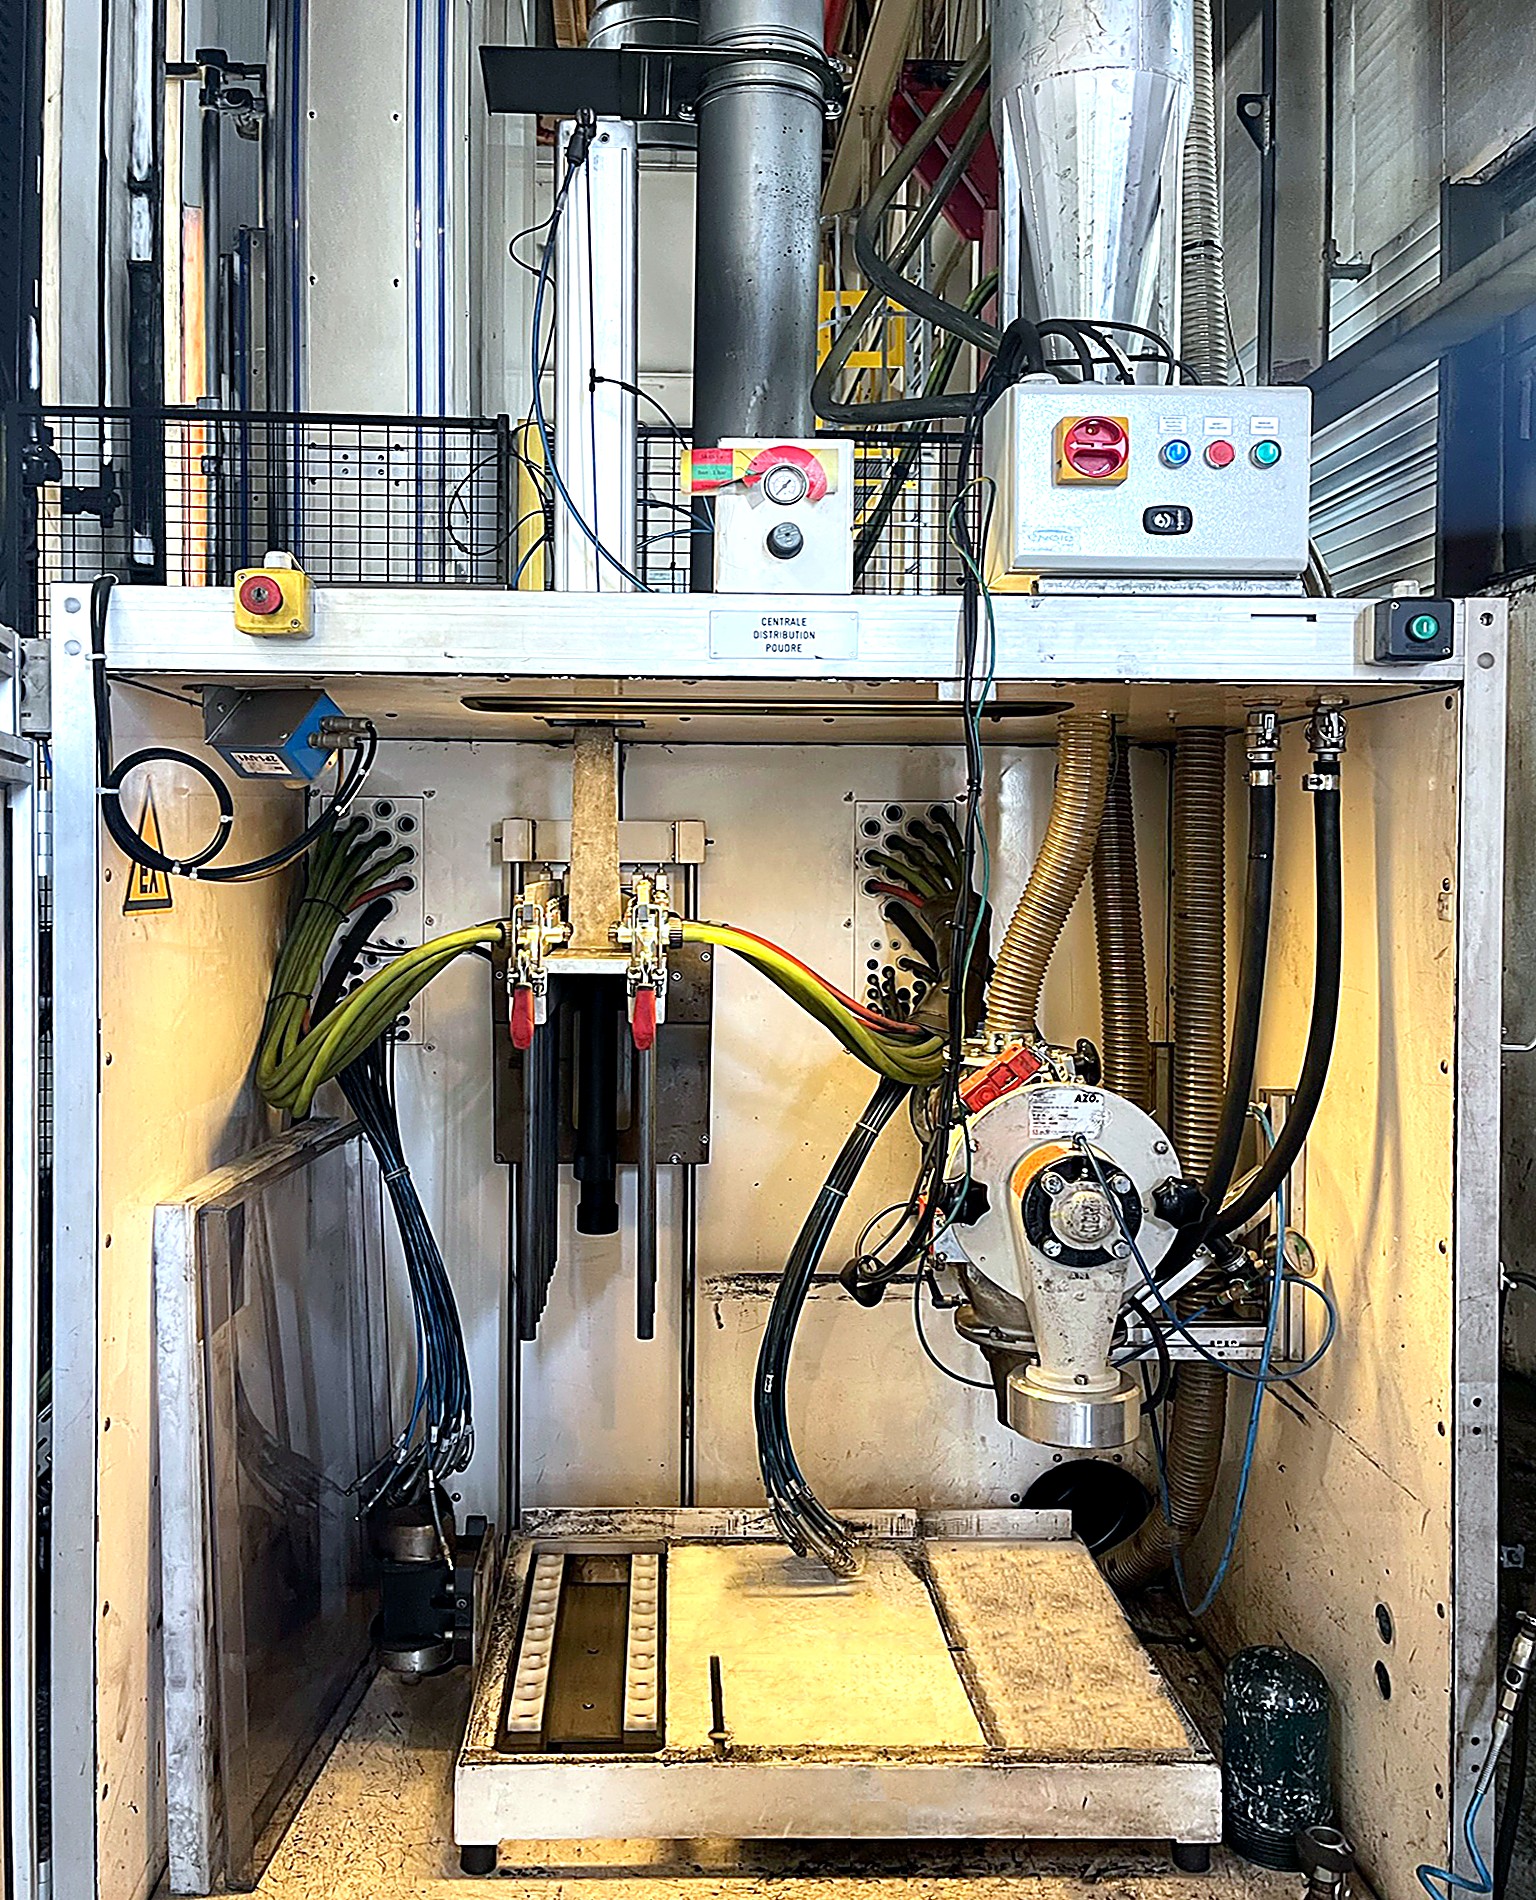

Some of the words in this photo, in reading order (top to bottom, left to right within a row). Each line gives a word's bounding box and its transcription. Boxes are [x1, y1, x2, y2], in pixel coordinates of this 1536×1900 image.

[761, 617, 807, 627] CENTRALE
[753, 630, 816, 640] DISTRIBUTION
[765, 643, 802, 653] POUDRE
